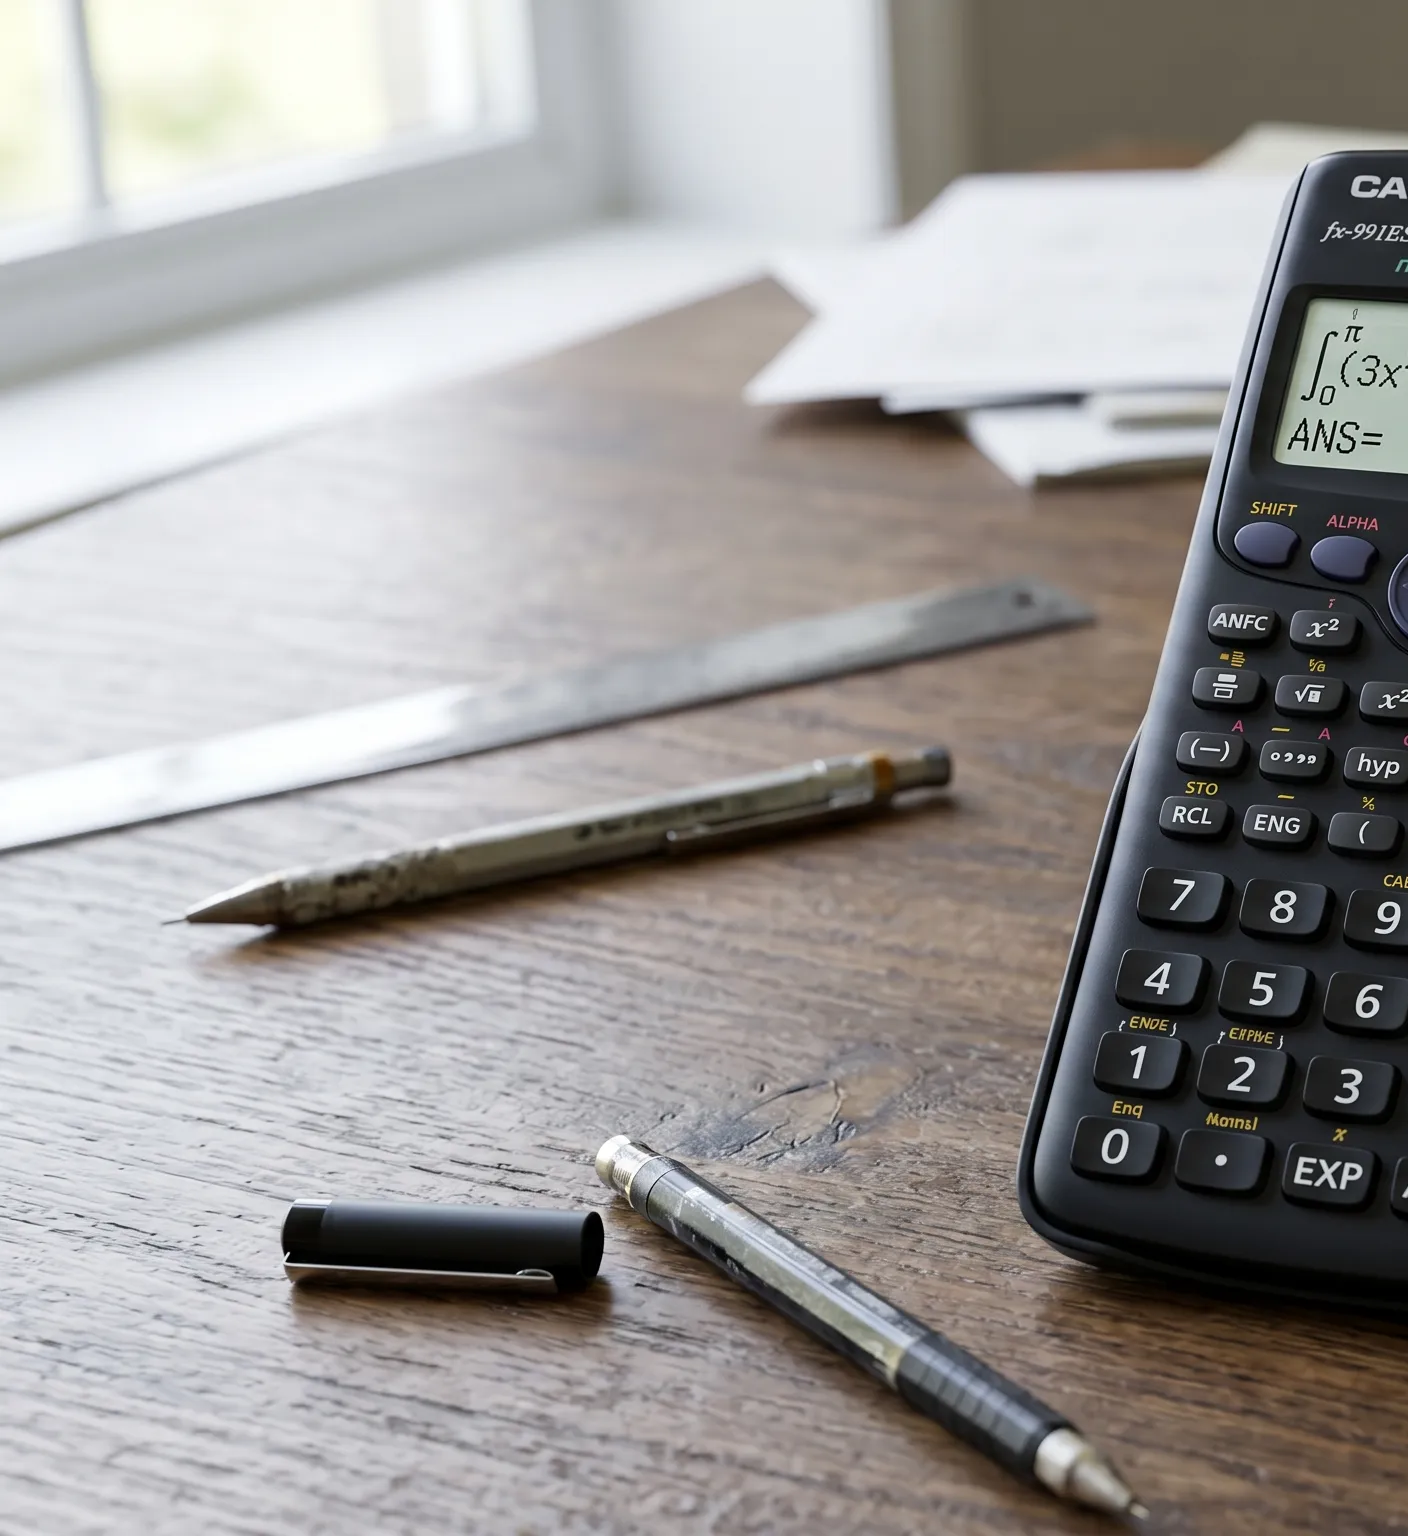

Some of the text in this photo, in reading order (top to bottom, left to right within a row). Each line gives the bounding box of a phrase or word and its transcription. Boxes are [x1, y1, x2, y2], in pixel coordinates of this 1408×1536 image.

[1288, 418, 1384, 454] ANS=
[1250, 501, 1297, 517] SHIFT
[1326, 514, 1379, 532] ALPHA
[1212, 612, 1268, 632] ANFC
[1231, 719, 1244, 733] A
[1318, 727, 1331, 740] A
[1357, 753, 1400, 779] hyp
[1185, 781, 1219, 796] STO
[1172, 805, 1212, 825] RCL
[1253, 814, 1301, 835] ENG
[1169, 878, 1196, 911] 7
[1269, 889, 1297, 924] 8
[1374, 901, 1401, 935] 9
[1143, 962, 1172, 995] 4
[1249, 971, 1277, 1007] 5
[1354, 983, 1384, 1019] 6
[1130, 1045, 1147, 1079] 1
[1227, 1056, 1256, 1093] 2
[1333, 1068, 1364, 1105] 3
[1101, 1128, 1130, 1165] 0
[1292, 1156, 1364, 1191] EXP
